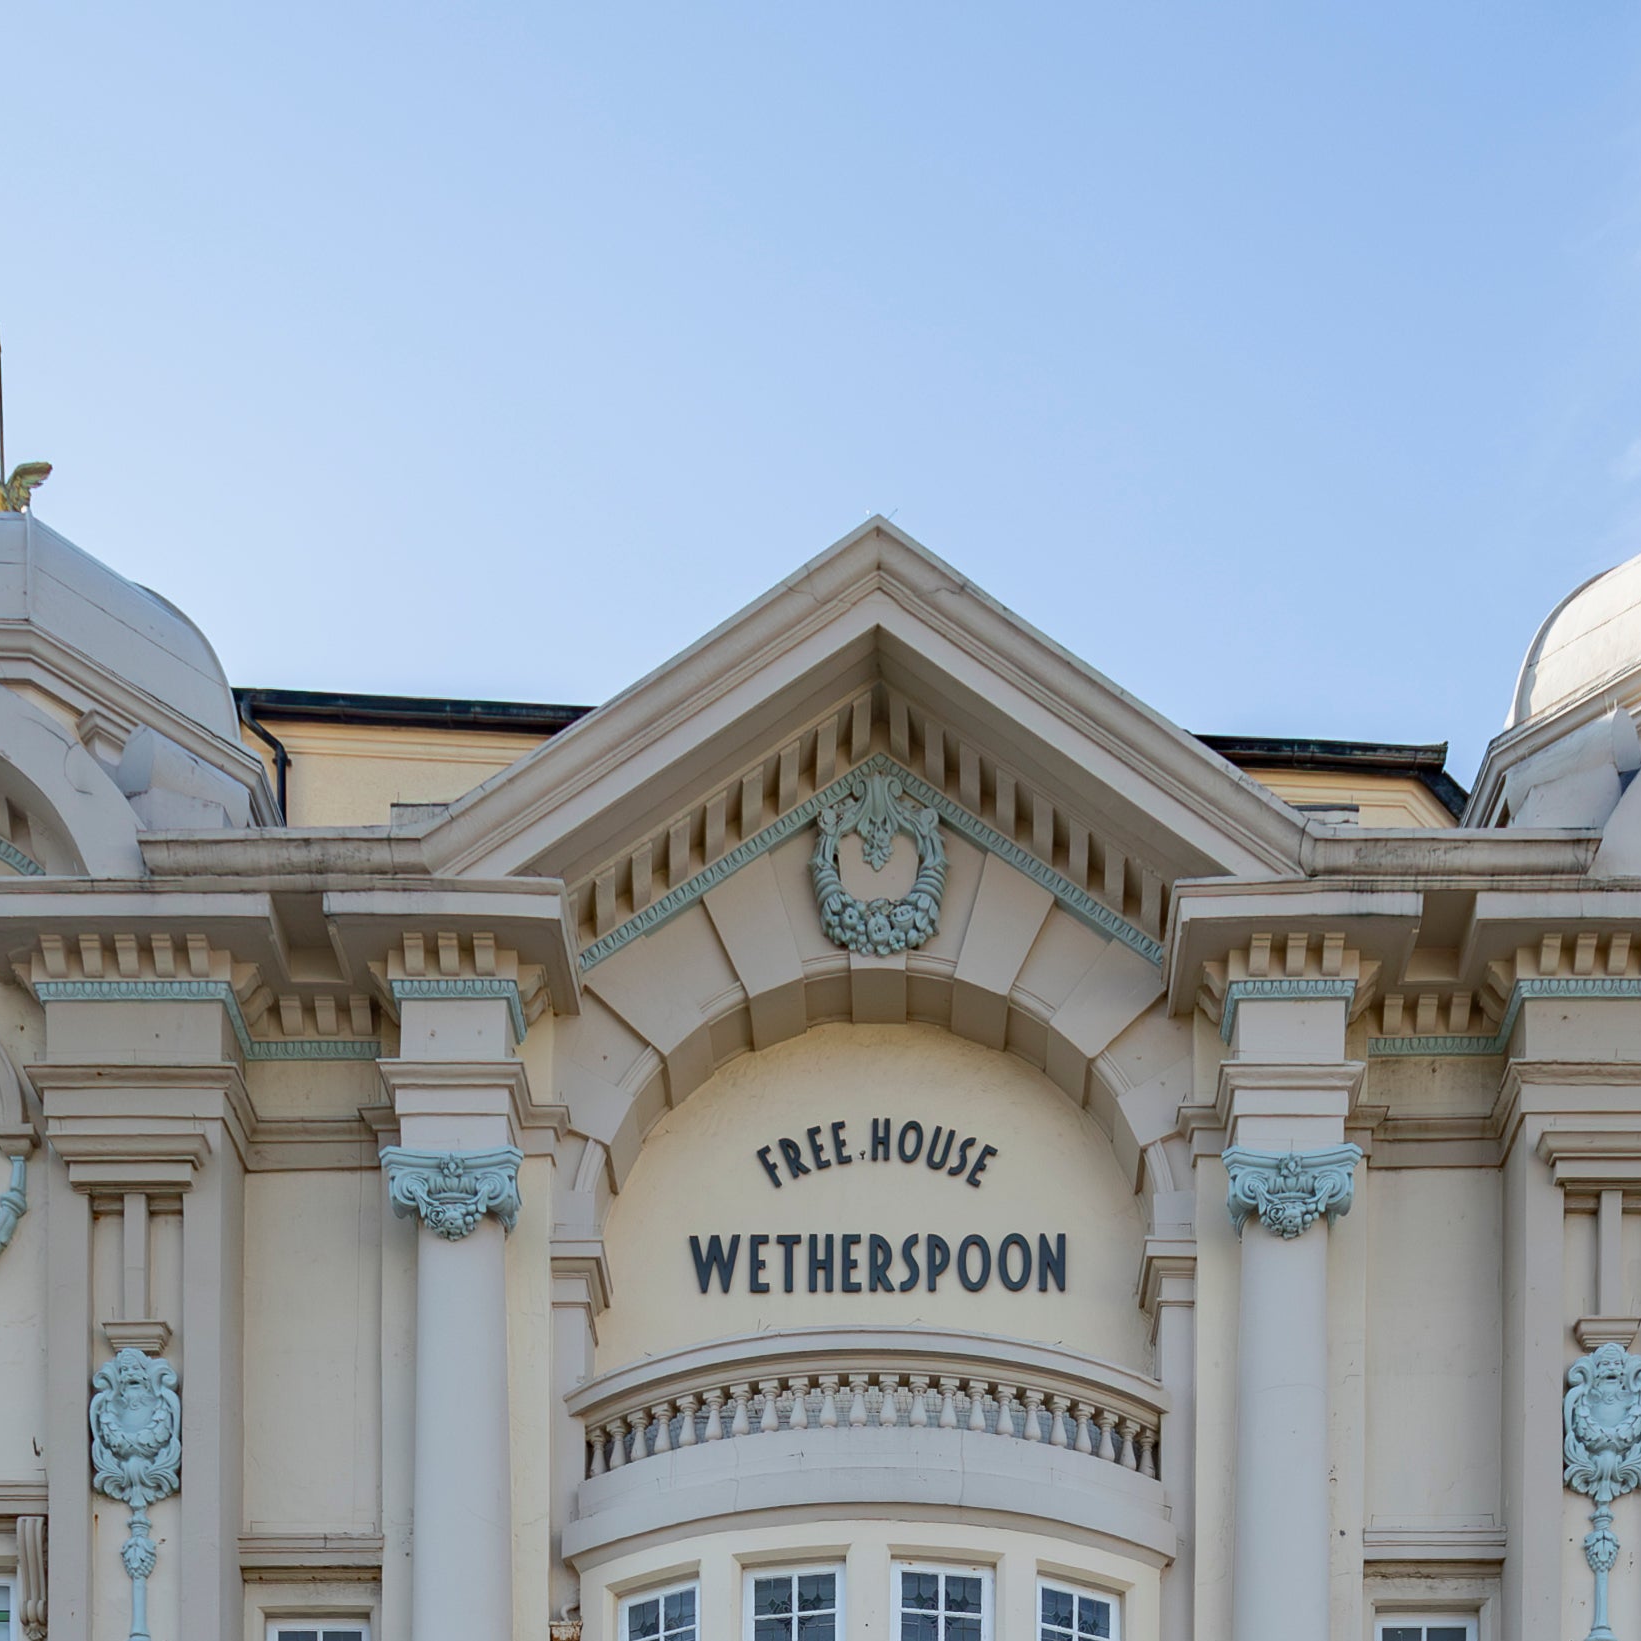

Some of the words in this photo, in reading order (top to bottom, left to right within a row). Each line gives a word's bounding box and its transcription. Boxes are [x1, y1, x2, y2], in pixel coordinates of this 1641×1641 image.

[757, 1120, 852, 1188] FREE
[871, 1118, 998, 1188] HOUSE
[690, 1232, 1066, 1294] WETHERSPOON
